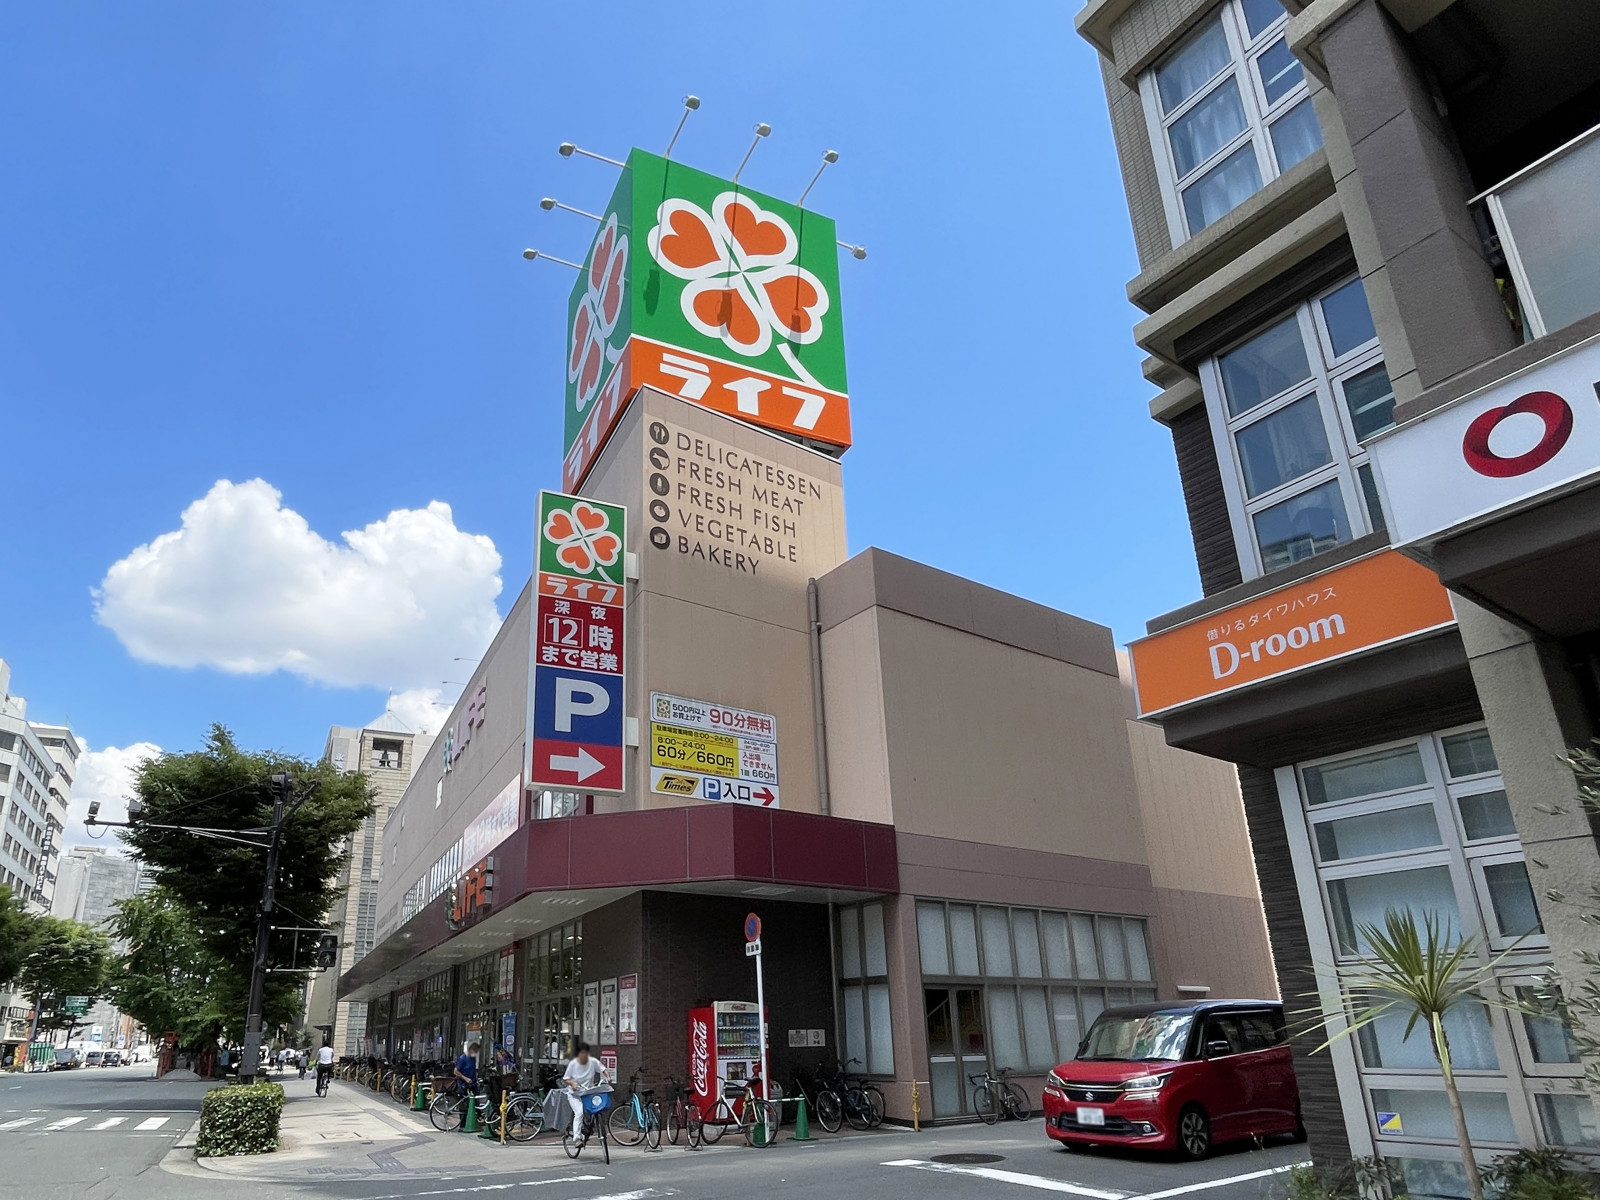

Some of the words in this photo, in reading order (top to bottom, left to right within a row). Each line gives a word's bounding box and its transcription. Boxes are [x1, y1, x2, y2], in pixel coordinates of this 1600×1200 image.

[660, 352, 826, 430] ライフ
[568, 361, 623, 484] ライフ
[677, 433, 822, 500] DELICATESSEN
[677, 458, 742, 495] FRESH
[752, 485, 804, 517] MEAT
[678, 482, 743, 521] FRESH
[754, 509, 797, 538] FISH
[678, 509, 798, 563] VEGETABLE
[678, 536, 760, 575] BAKERY
[546, 576, 618, 603] ライフ
[554, 599, 607, 621] 深夜
[548, 617, 614, 651] 12時
[1206, 586, 1338, 642] 借りるダイワハウス
[542, 645, 618, 672] まで営業
[1208, 613, 1347, 680] D-room
[452, 676, 487, 761] LIFE
[554, 676, 611, 733] P
[672, 703, 706, 717] 500円以上
[709, 708, 771, 734] 90分無料
[664, 780, 692, 792] Times
[742, 760, 773, 771] できません
[752, 769, 776, 780] 660円
[723, 782, 751, 801] 入口
[693, 1017, 708, 1097] Coca-Cola
